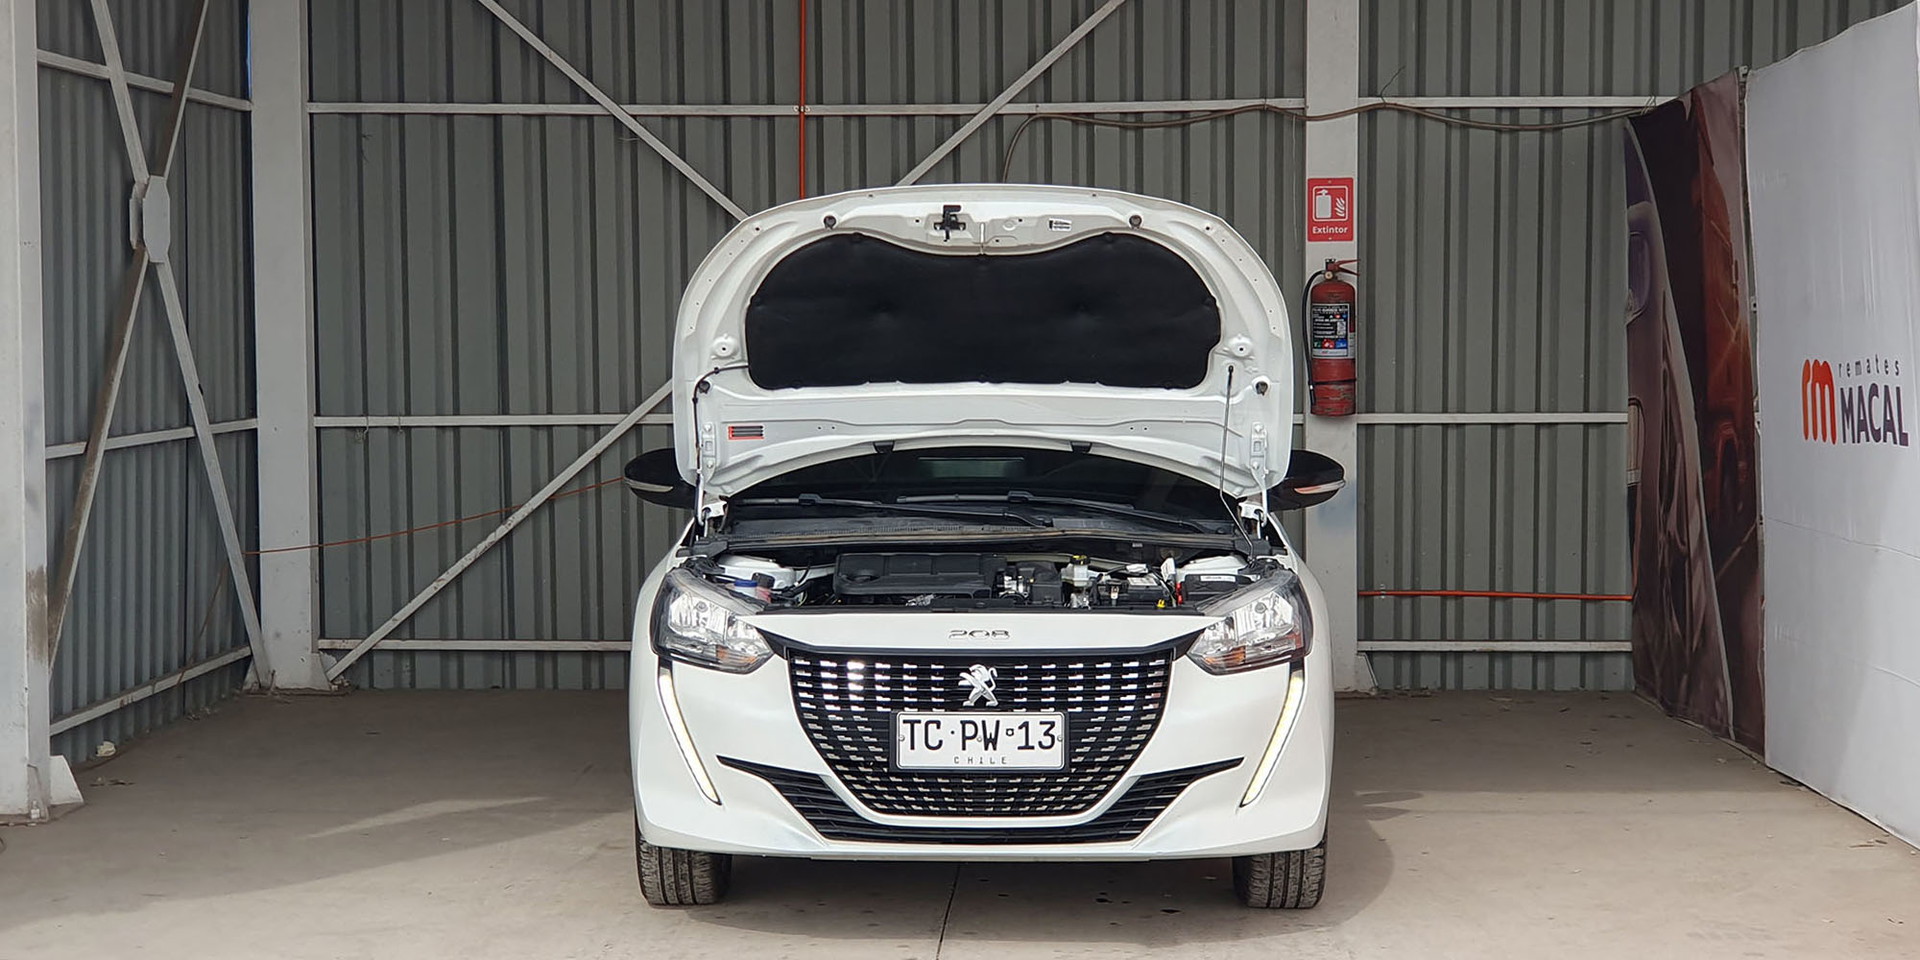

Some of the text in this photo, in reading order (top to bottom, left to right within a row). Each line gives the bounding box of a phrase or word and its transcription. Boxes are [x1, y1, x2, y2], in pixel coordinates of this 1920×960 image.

[1312, 226, 1348, 234] Extintor
[1838, 354, 1900, 378] remates
[1840, 383, 1909, 447] MACAL
[948, 629, 1011, 640] 208
[953, 756, 1008, 764] CHILE
